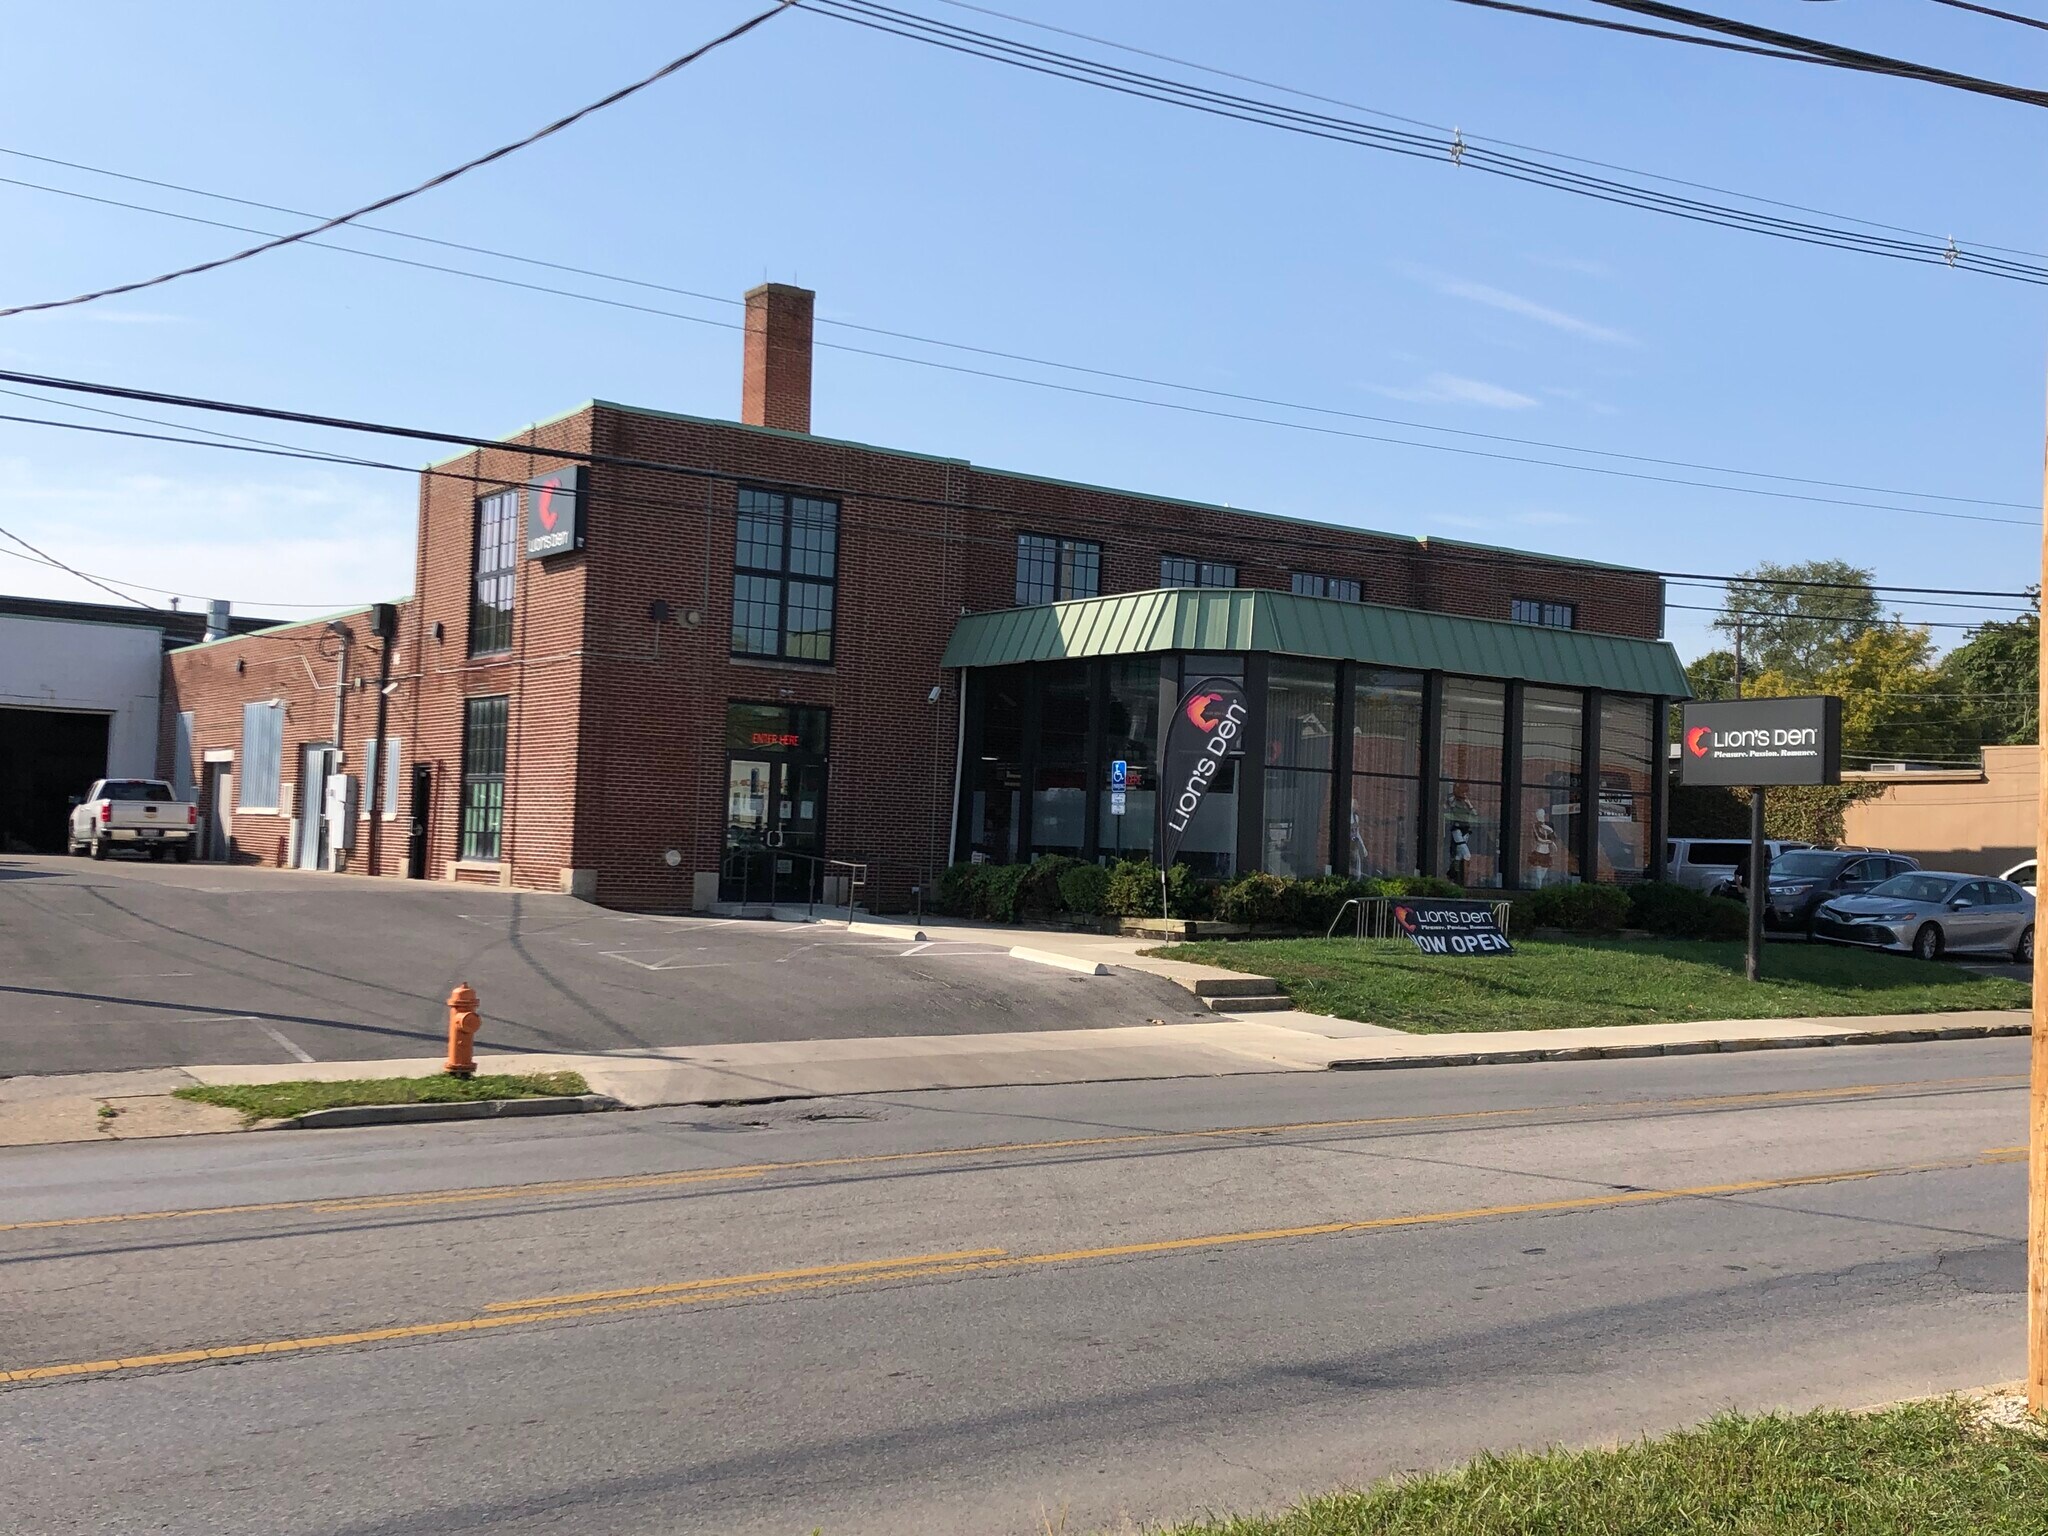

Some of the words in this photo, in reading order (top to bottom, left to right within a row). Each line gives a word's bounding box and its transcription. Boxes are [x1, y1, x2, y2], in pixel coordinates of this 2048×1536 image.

[752, 732, 777, 744] ENTER
[780, 734, 799, 746] HERE
[1450, 933, 1511, 953] OPEN
